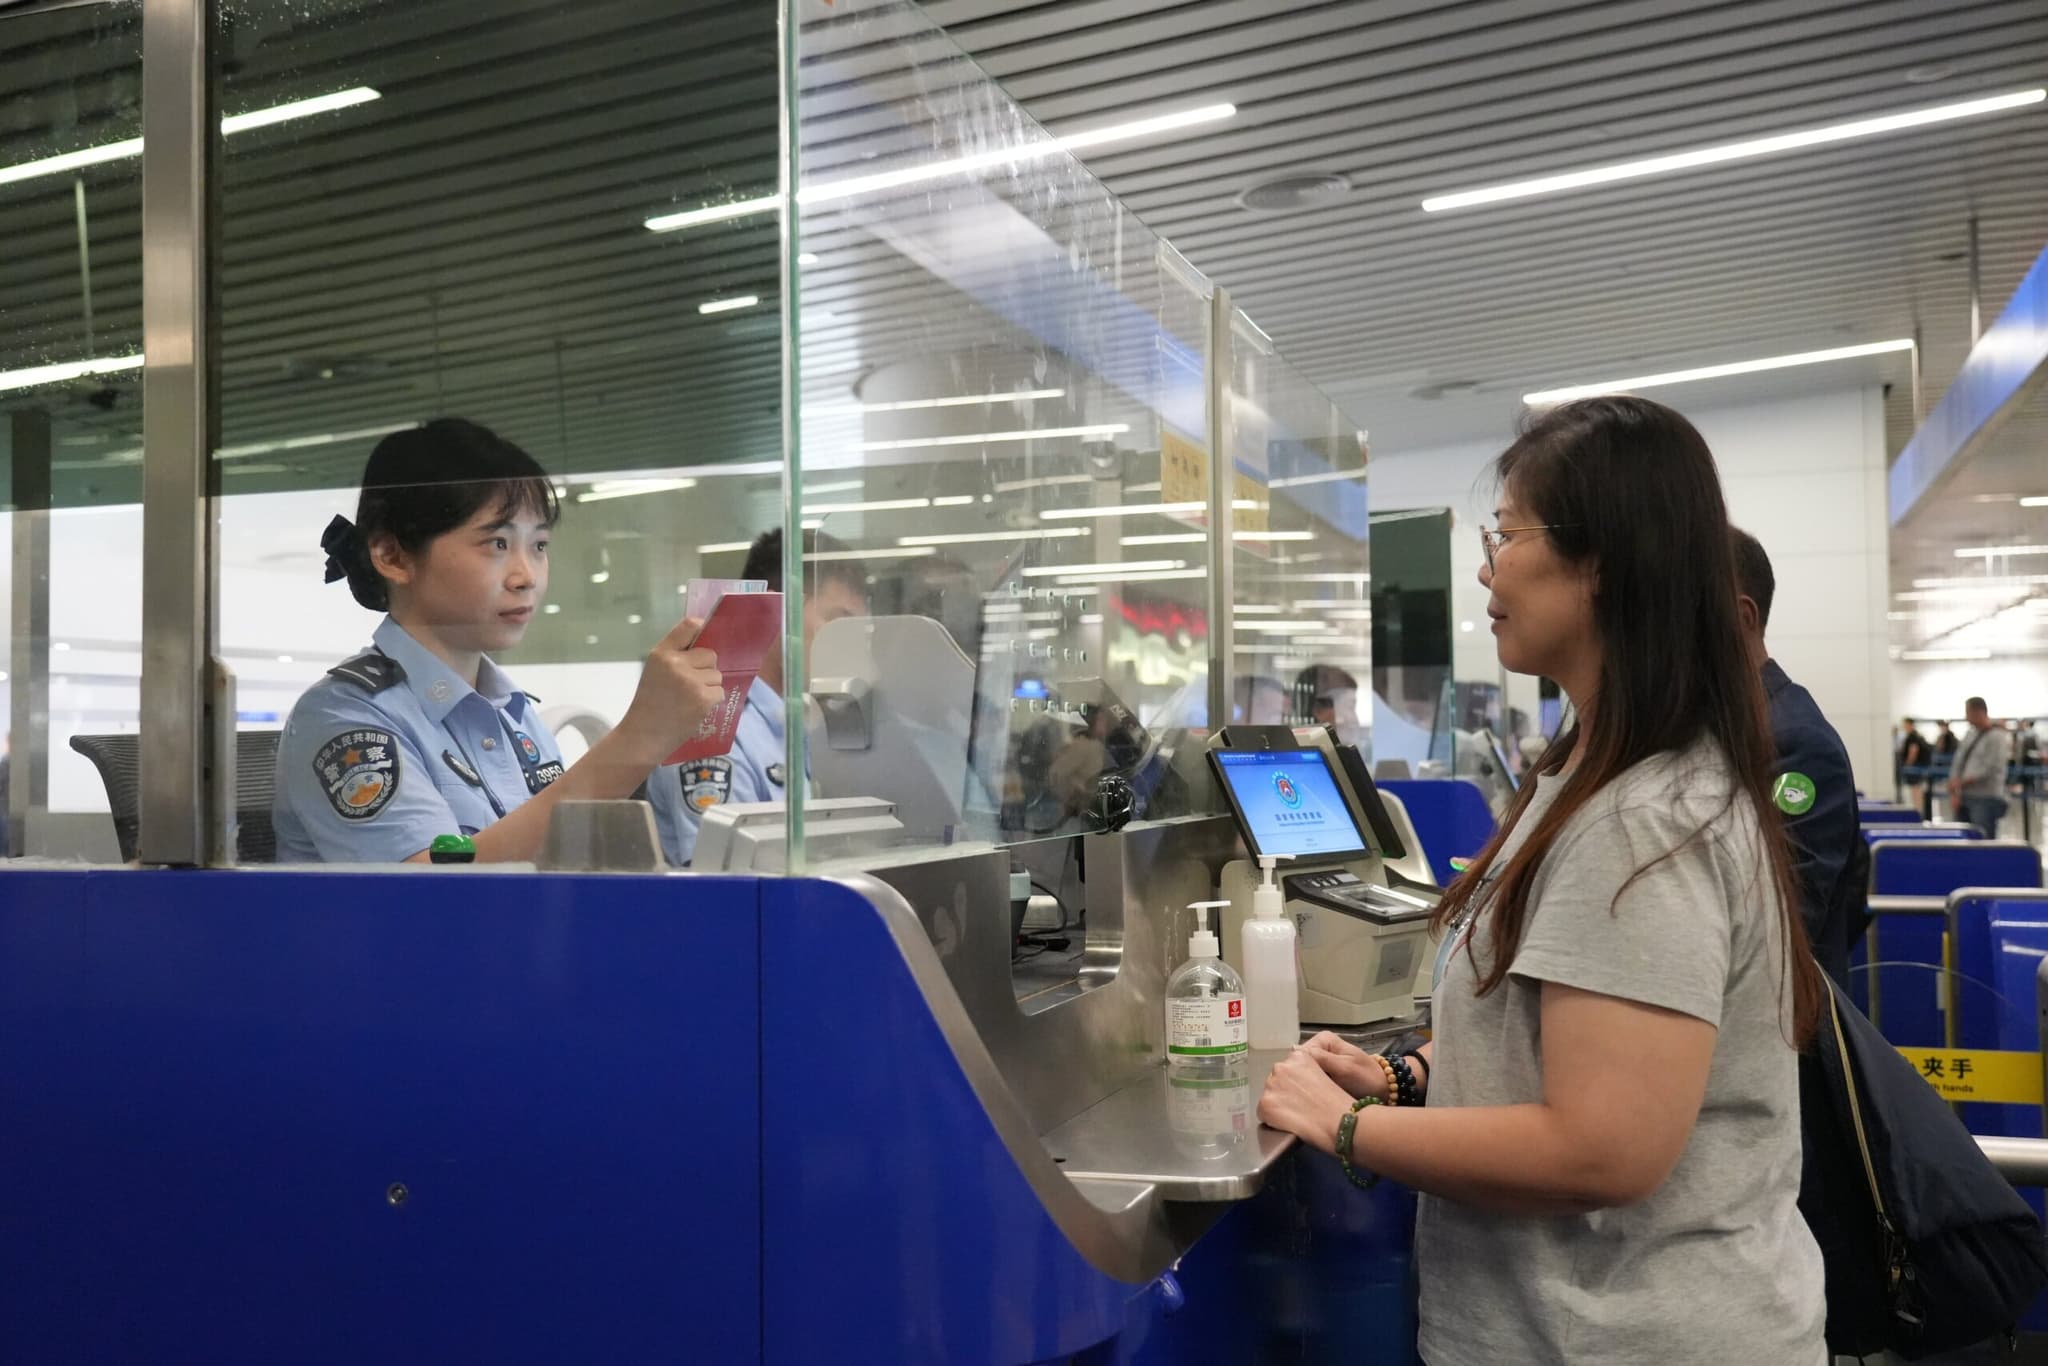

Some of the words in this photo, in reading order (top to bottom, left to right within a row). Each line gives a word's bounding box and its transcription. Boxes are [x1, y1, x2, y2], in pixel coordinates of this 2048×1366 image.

[316, 731, 389, 771] 中华人民共和国
[1911, 1057, 1973, 1079] 夹手
[1943, 1084, 1974, 1093] hands
